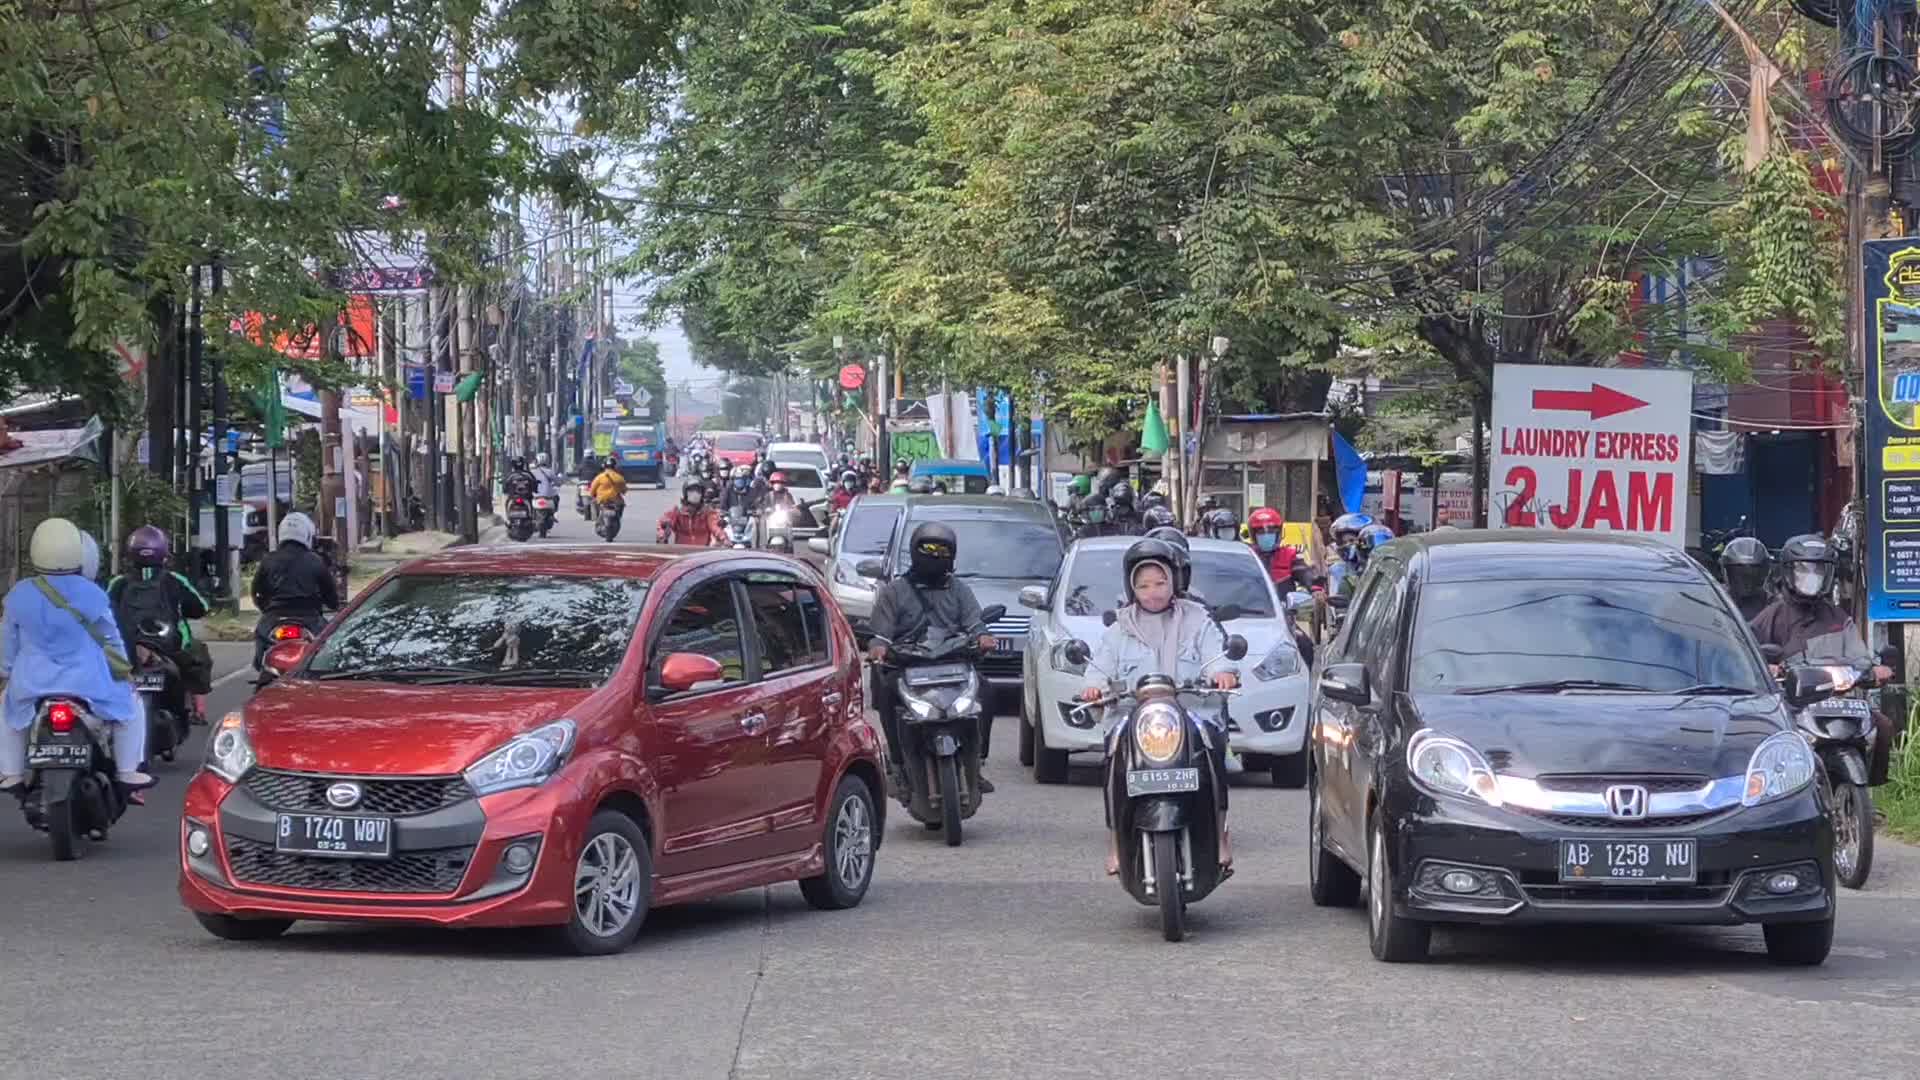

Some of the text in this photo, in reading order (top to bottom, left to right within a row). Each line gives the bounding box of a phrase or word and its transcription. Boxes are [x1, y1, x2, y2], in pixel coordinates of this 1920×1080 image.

[1501, 426, 1680, 462] LAUNDRY EXPRESS
[1504, 466, 1537, 528] 2
[1549, 468, 1674, 532] JAM
[1142, 772, 1170, 782] 6155
[280, 816, 291, 837] B
[305, 817, 343, 840] 1740
[1567, 843, 1689, 866] AB 1258 NU
